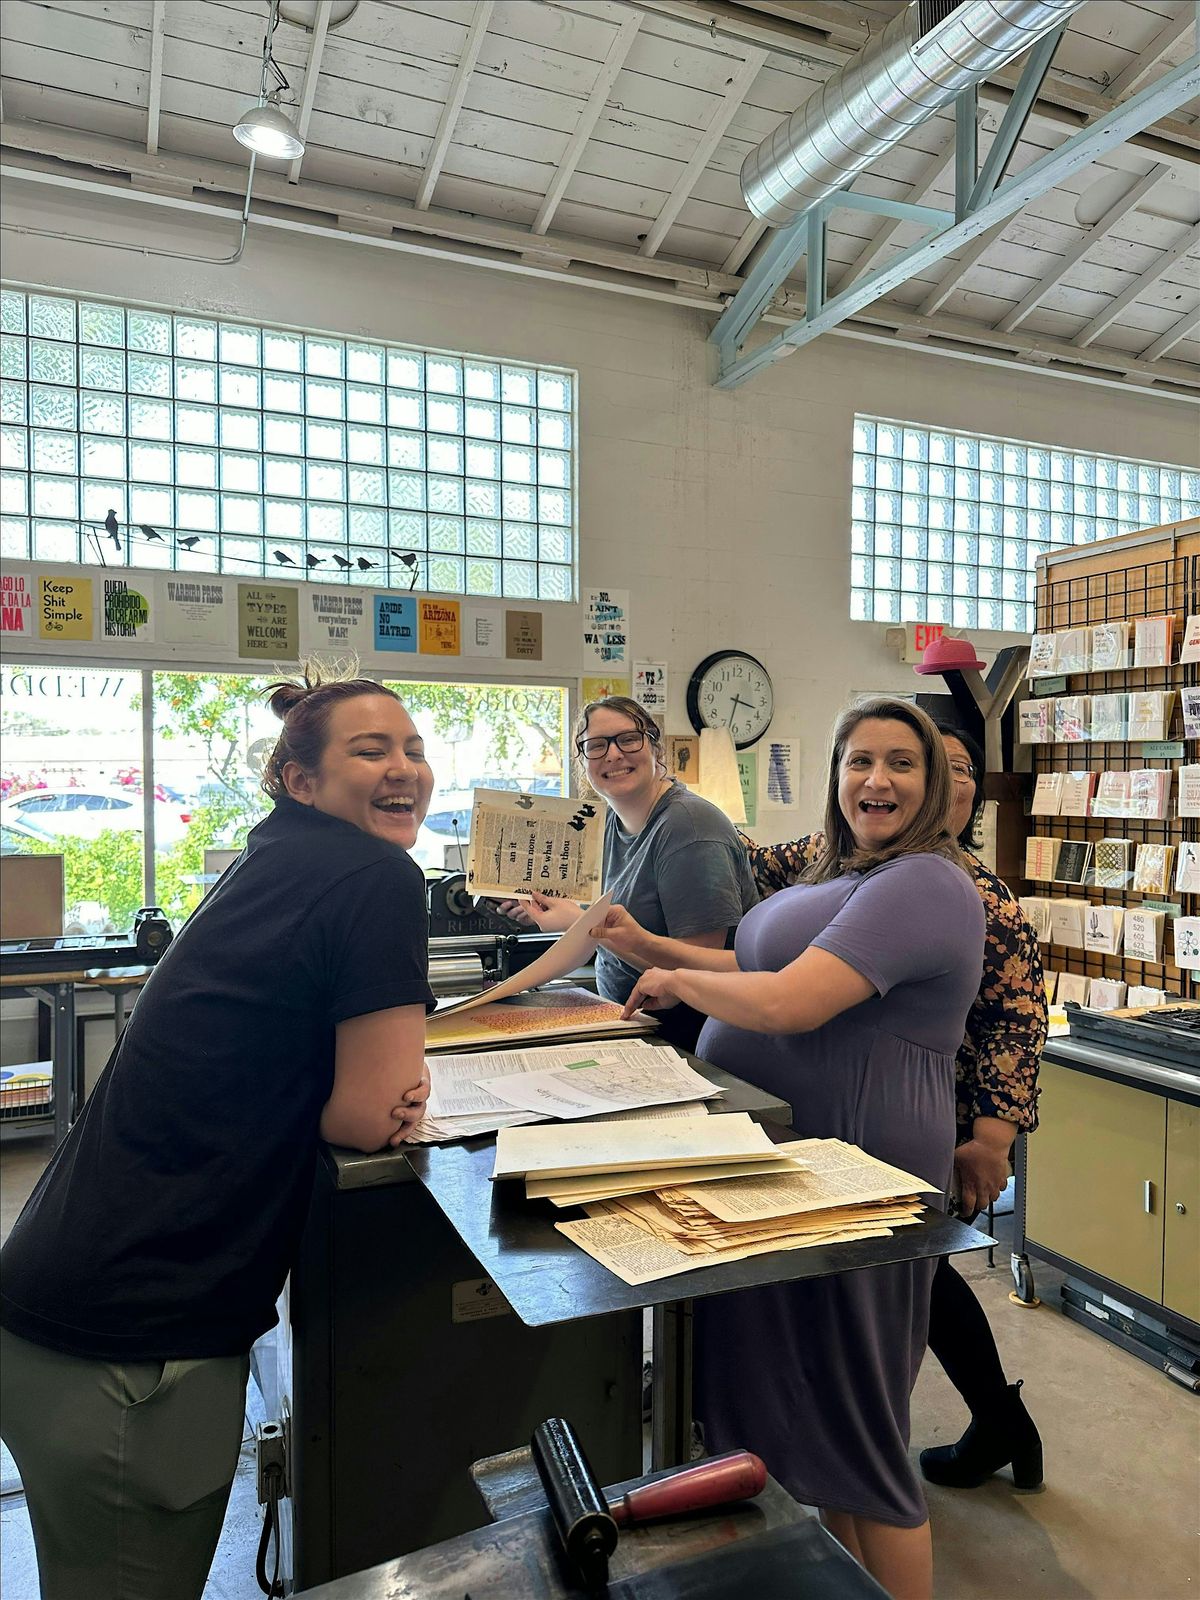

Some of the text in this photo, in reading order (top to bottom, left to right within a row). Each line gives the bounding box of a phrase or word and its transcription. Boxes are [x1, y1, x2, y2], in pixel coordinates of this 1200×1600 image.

[15, 576, 24, 592] LO
[43, 580, 73, 594] Keep
[104, 580, 128, 594] QUEDA
[168, 582, 223, 604] WARBIRD PRESS
[246, 591, 262, 600] ALL
[8, 592, 19, 607] DA
[21, 593, 31, 608] LA
[44, 595, 66, 607] Shit
[105, 594, 140, 609] PROHIBIDO
[246, 602, 287, 614] TYPES
[344, 597, 362, 615] PRESS
[379, 602, 402, 614] ABIDE
[0, 608, 24, 631] NA
[43, 608, 83, 621] Simple
[105, 609, 148, 624] NO CREAR MI
[318, 615, 357, 625] everywhere is
[379, 614, 390, 624] NO
[423, 610, 456, 621] ARIZONA
[271, 617, 287, 625] ARE
[104, 622, 136, 637] HISTORIA
[247, 626, 287, 638] WELCOME
[328, 626, 348, 638] WAR!
[247, 640, 268, 648] HERE
[584, 634, 625, 645] WA LESS
[722, 671, 730, 681] 11
[732, 667, 743, 678] 12
[712, 682, 723, 692] 10
[754, 682, 760, 692] 2
[707, 694, 714, 704] 9
[759, 697, 766, 707] 3
[710, 709, 718, 719] 8
[754, 711, 760, 720] 4
[721, 719, 727, 727] 7
[731, 723, 739, 734] 6
[746, 720, 752, 731] 5
[509, 851, 516, 862] an
[541, 840, 553, 878] Do what
[559, 840, 570, 880] wilt thou
[523, 857, 533, 882] harm
[1133, 915, 1144, 923] 480
[1133, 924, 1144, 932] 520
[1133, 941, 1144, 949] 623
